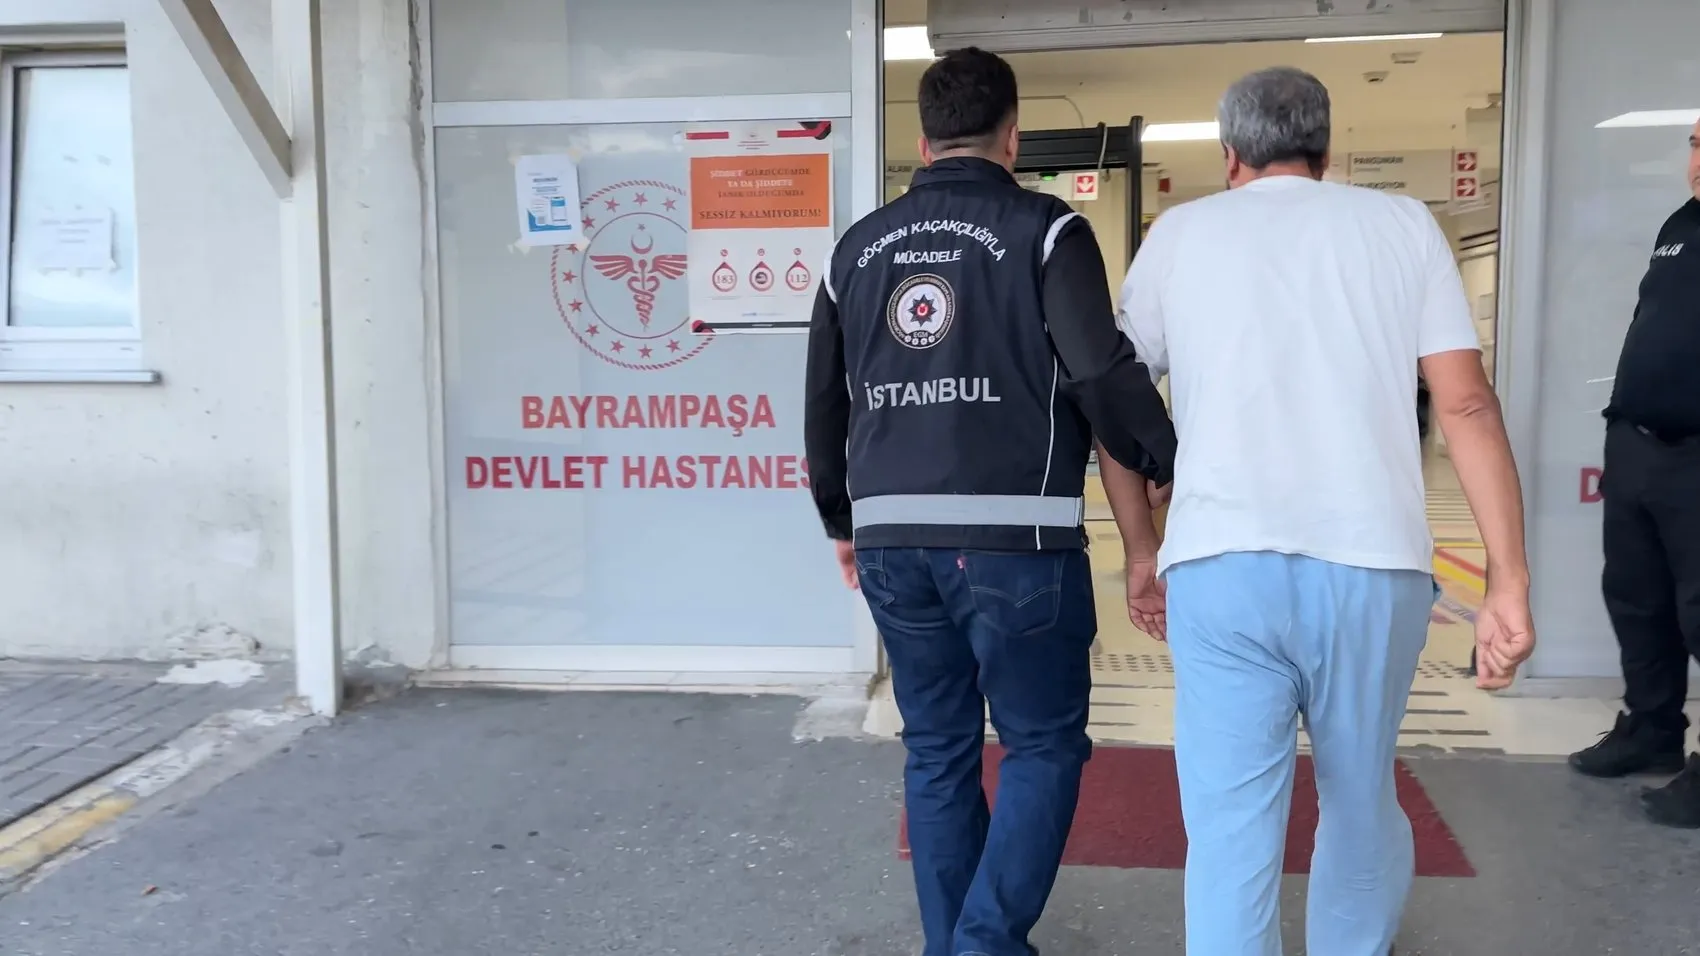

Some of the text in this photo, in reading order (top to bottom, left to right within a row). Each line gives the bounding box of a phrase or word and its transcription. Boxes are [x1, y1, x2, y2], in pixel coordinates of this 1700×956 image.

[857, 220, 1006, 268] GÖÇMEN KAÇAKÇILIĞIYLA
[893, 249, 963, 265] MÜCADELE
[716, 274, 734, 284] 183
[791, 274, 808, 283] 112
[864, 377, 1001, 411] İSTANBUL
[521, 394, 776, 437] BAYRAMPAŞA
[465, 455, 608, 489] DEVLET
